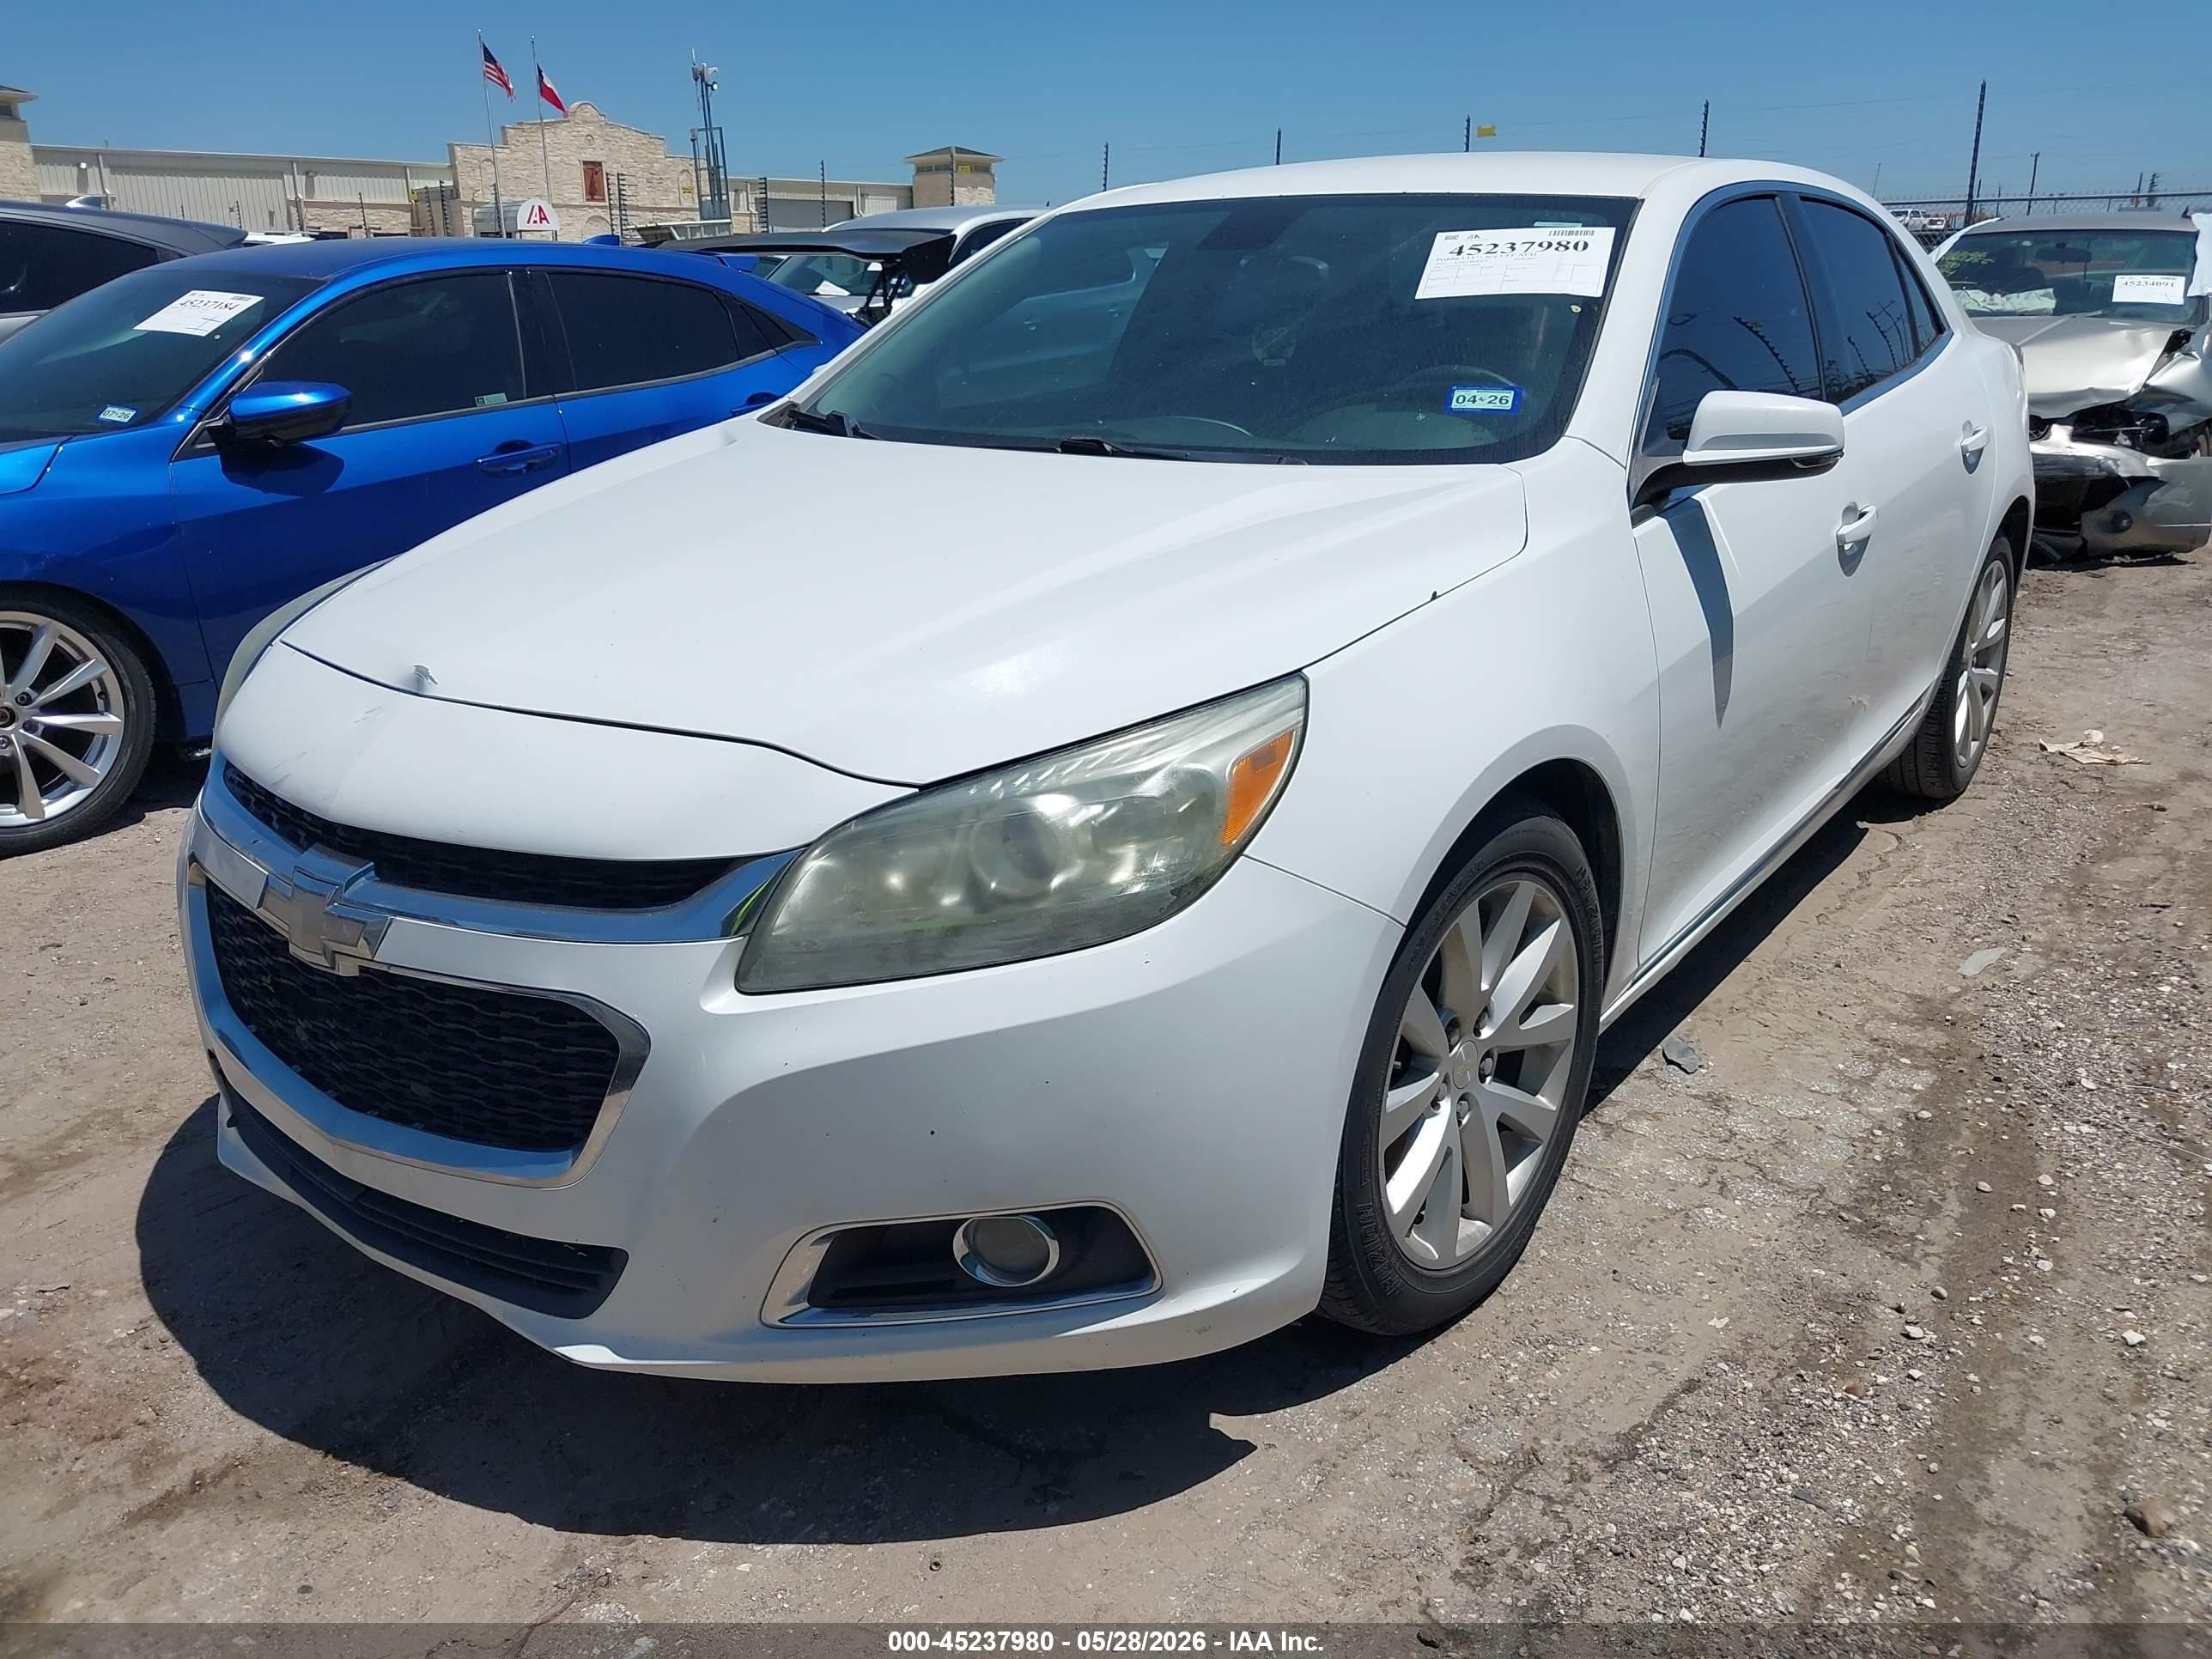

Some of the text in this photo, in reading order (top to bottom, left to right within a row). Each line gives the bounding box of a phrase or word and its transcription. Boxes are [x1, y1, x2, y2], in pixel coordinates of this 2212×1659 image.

[1449, 240, 1589, 257] 45237980
[1455, 394, 1510, 405] 04 26
